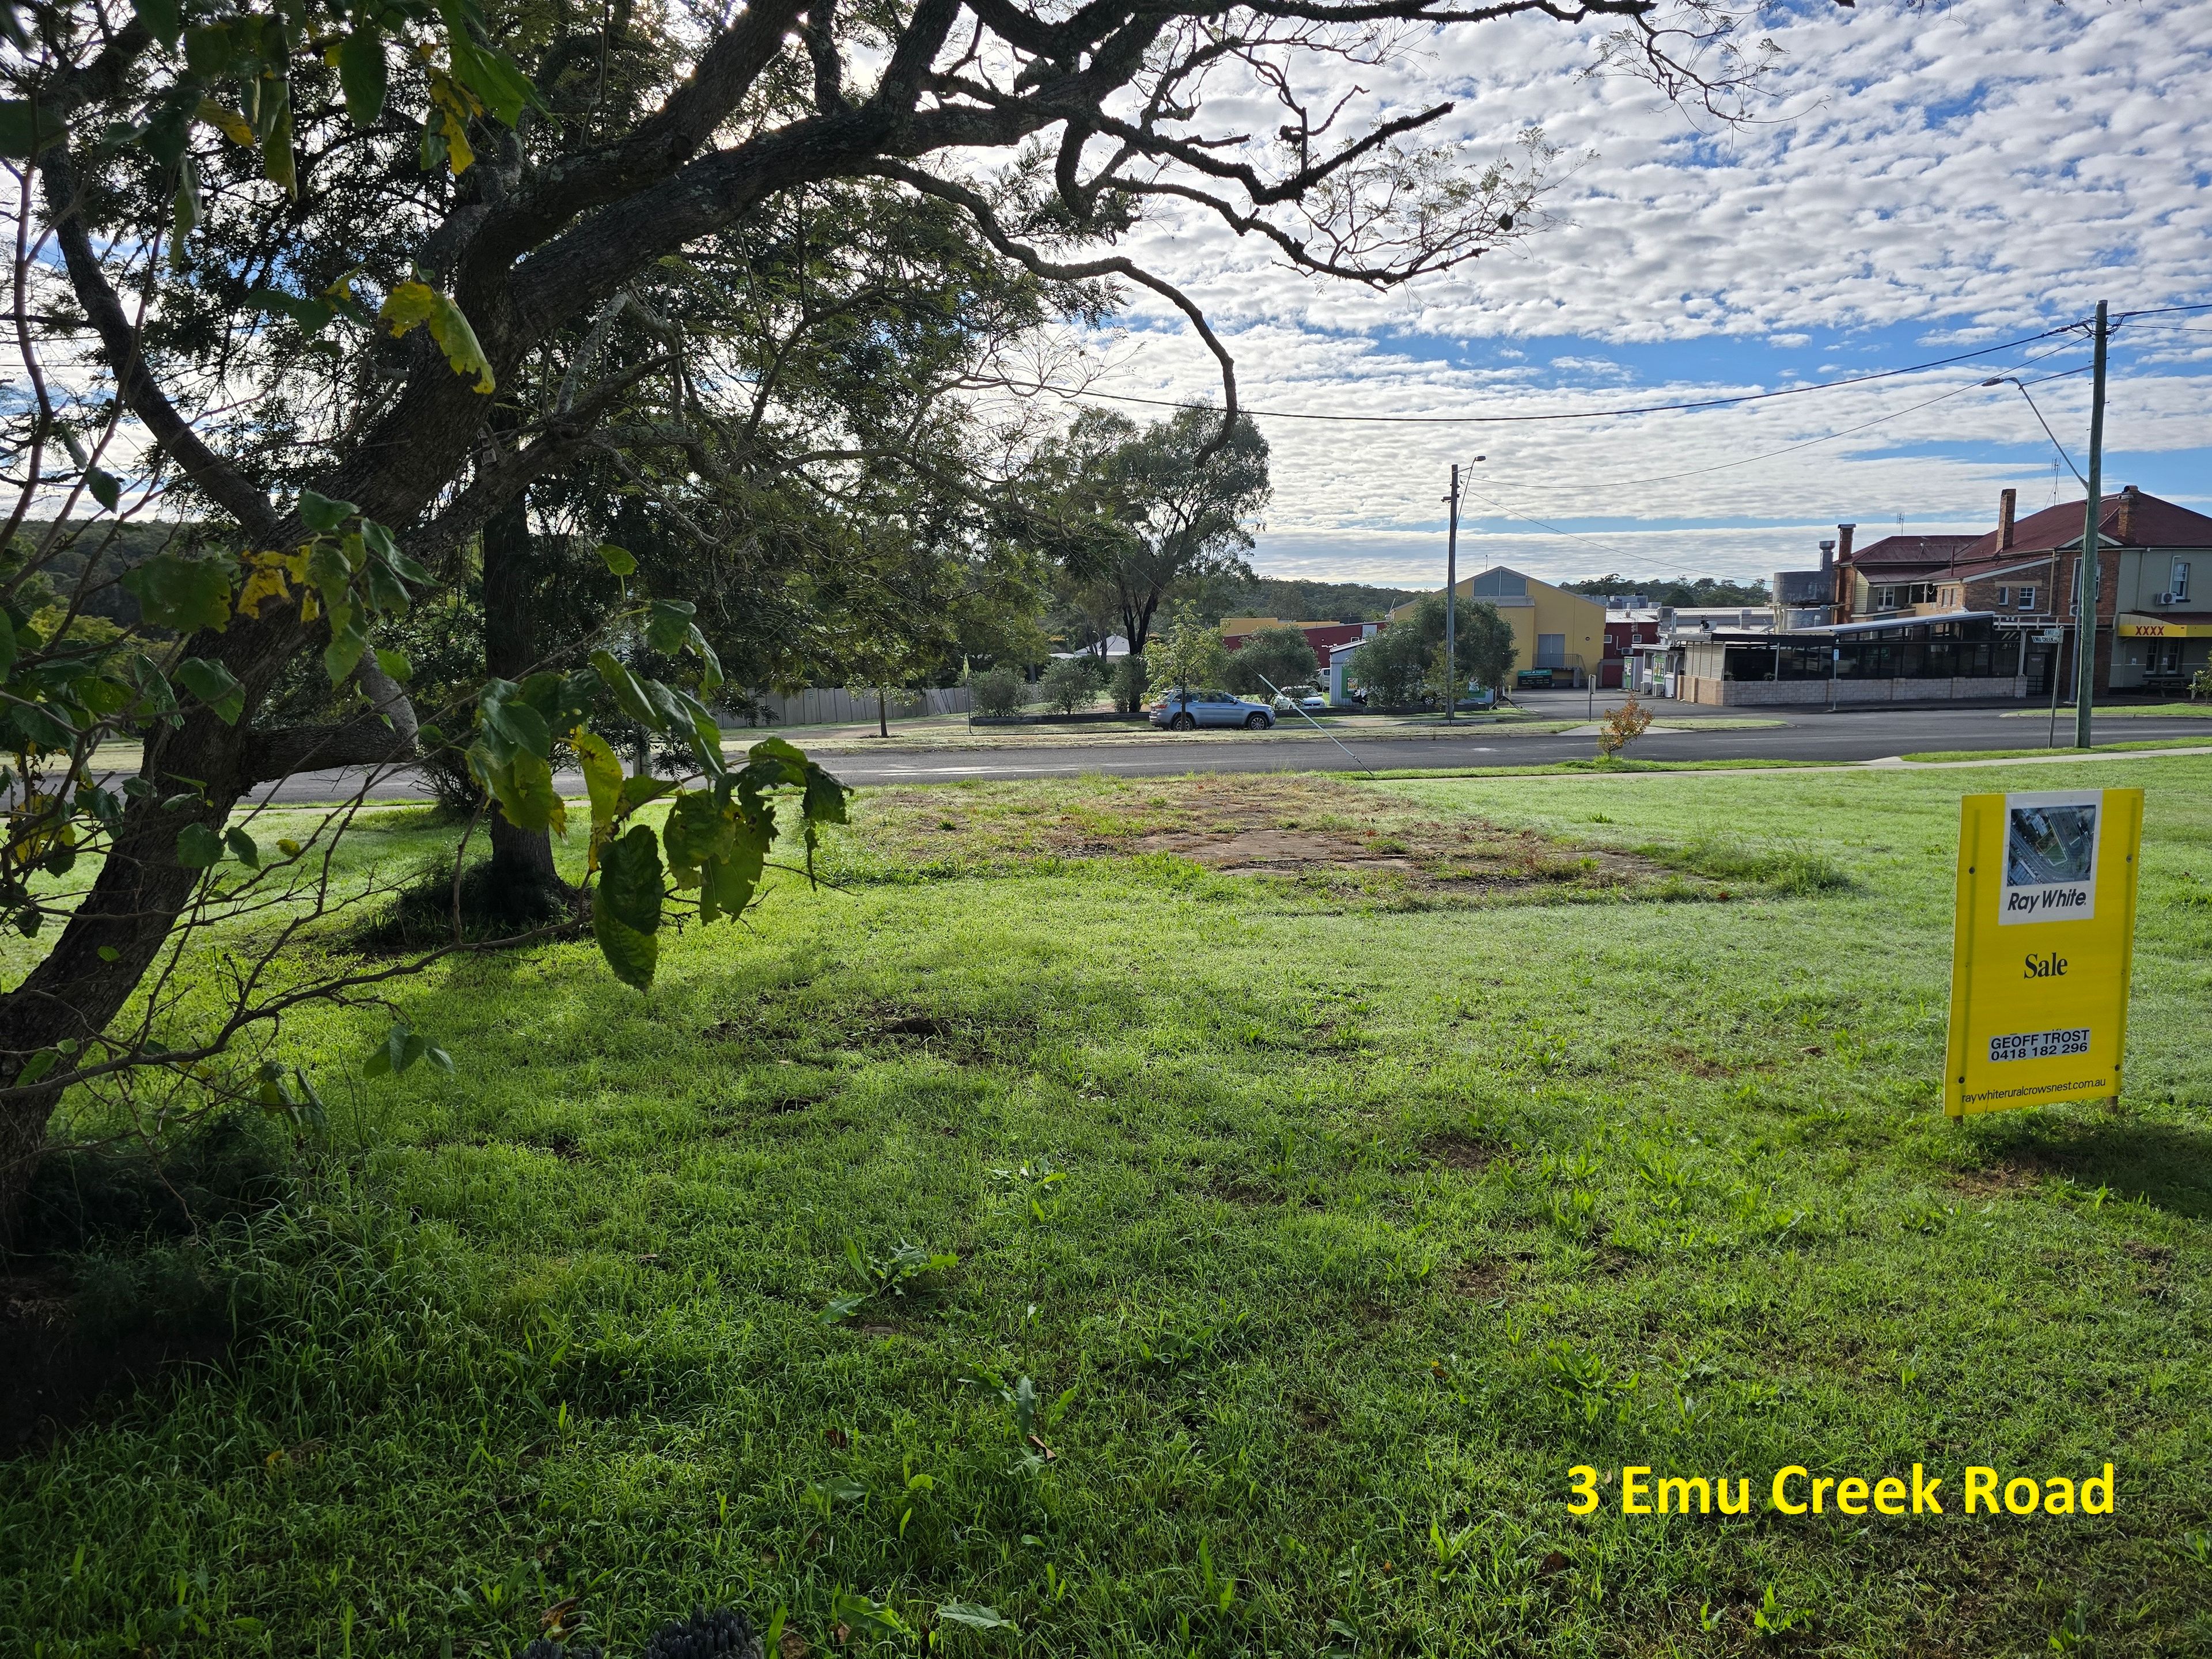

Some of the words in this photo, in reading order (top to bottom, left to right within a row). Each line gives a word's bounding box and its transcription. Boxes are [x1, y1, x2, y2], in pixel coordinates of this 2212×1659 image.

[2135, 626, 2165, 636] XXXX
[2008, 892, 2040, 914] Ray
[2024, 952, 2068, 979] Sale
[1991, 1034, 2039, 1050] GEOFF
[2043, 1029, 2090, 1044] TROST
[1991, 1048, 2027, 1061] 0418
[2032, 1045, 2057, 1056] 182
[2062, 1043, 2088, 1054] 296
